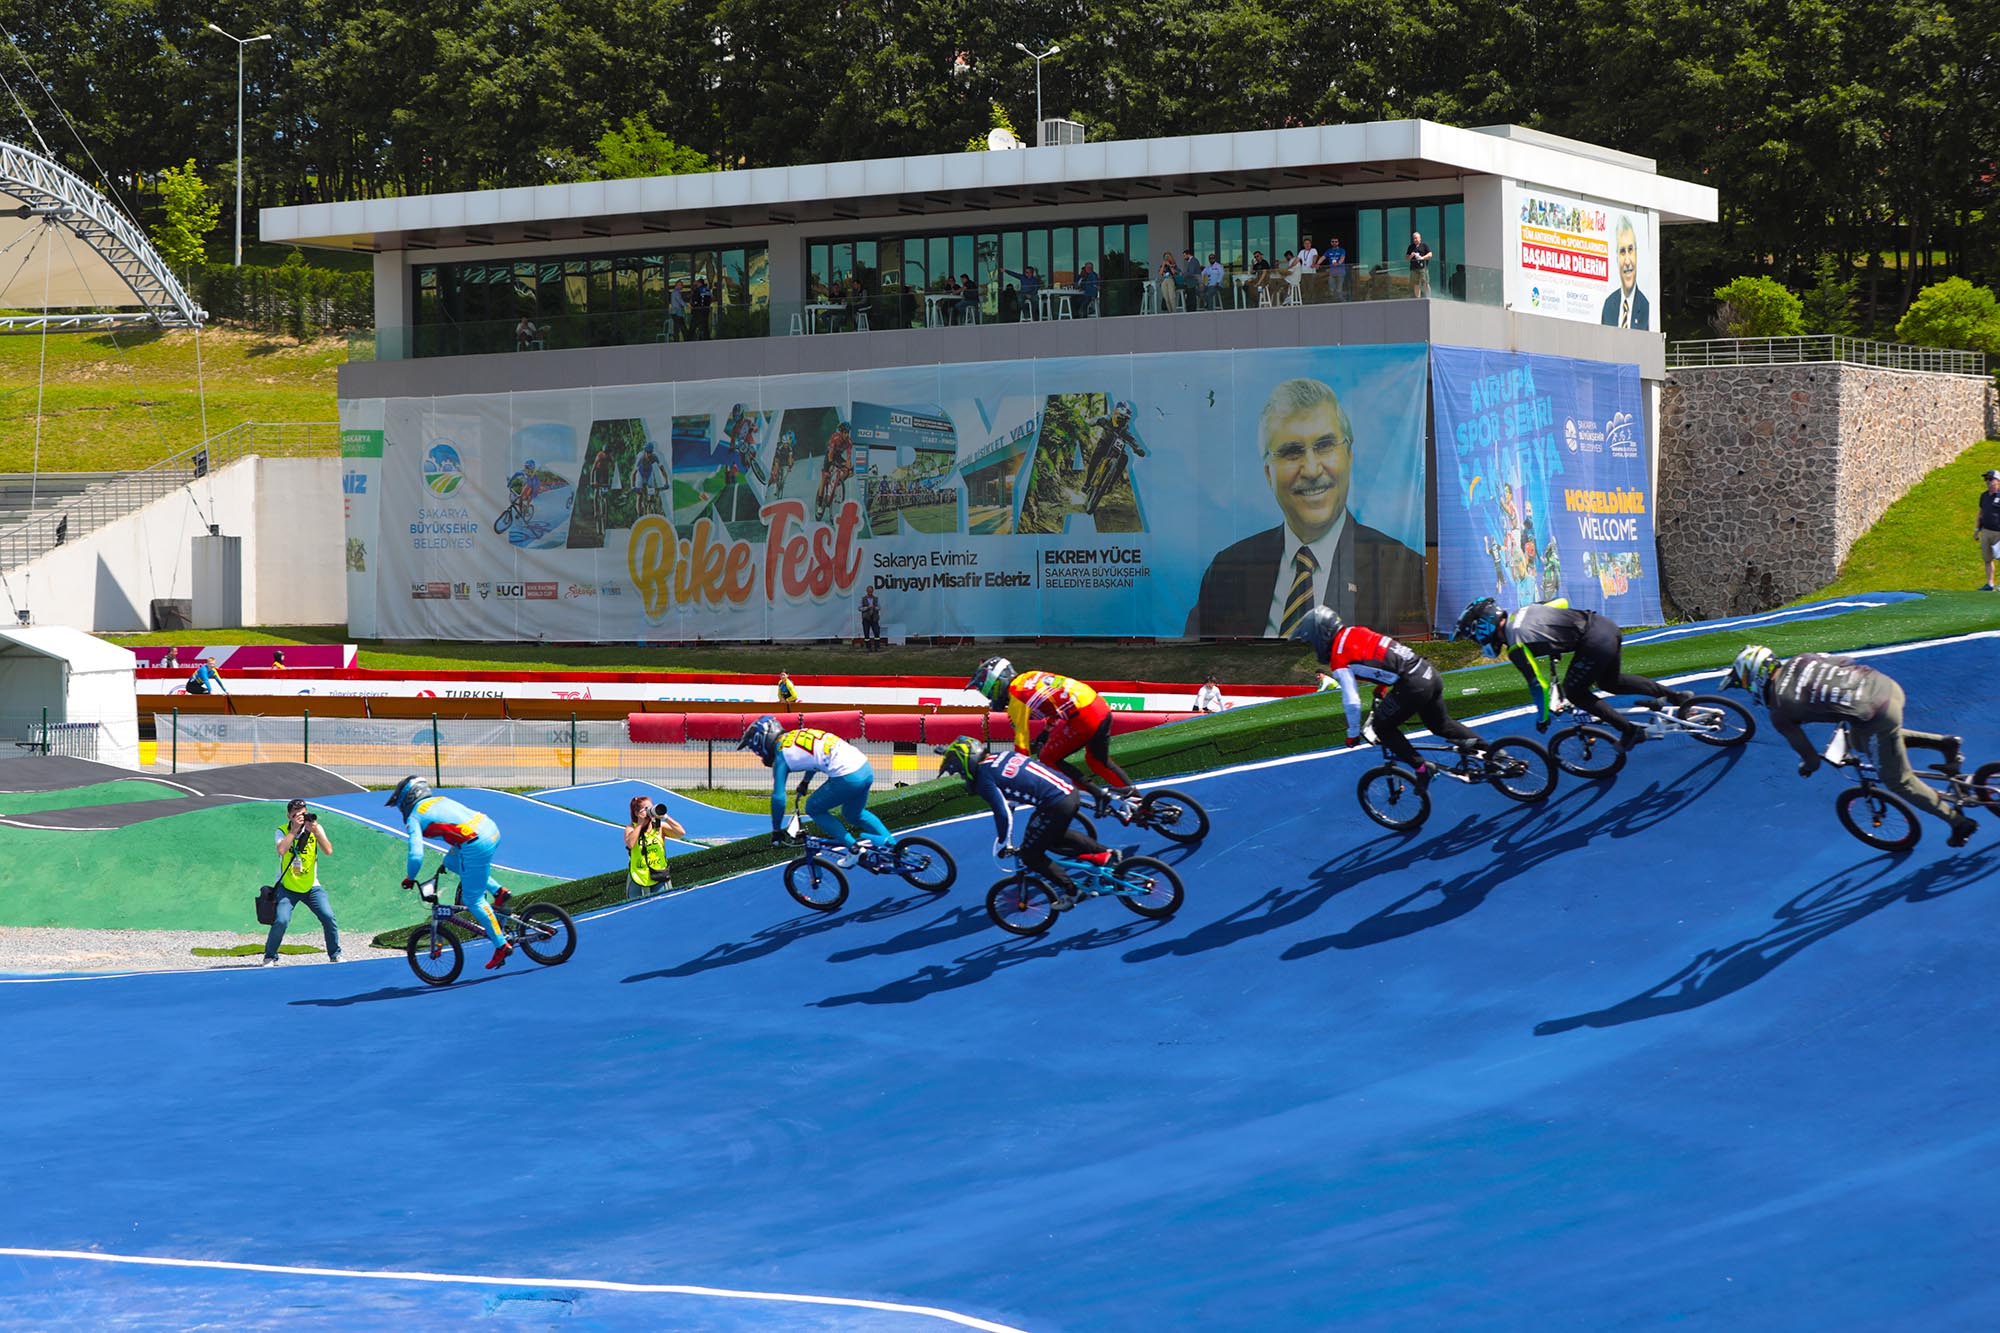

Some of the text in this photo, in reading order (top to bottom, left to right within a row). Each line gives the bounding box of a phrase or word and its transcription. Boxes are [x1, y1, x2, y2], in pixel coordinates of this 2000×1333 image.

[1522, 246, 1607, 277] BAŞARILAR DİLERİM
[894, 415, 912, 425] UCI
[1456, 411, 1500, 457] SPOR
[418, 508, 469, 519] SAKARYA
[1577, 515, 1639, 541] WELCOME
[628, 500, 863, 617] Bike Fest
[873, 549, 978, 570] Sakarya Evimiz
[1044, 546, 1142, 564] EKREM YÜCE
[873, 571, 1031, 592] Dünyayı Misafir Ederiz
[1045, 565, 1151, 579] SAKARYA BÜYÜKŞEHİR
[501, 585, 524, 596] UCI
[1091, 577, 1134, 589] BAŞKANI
